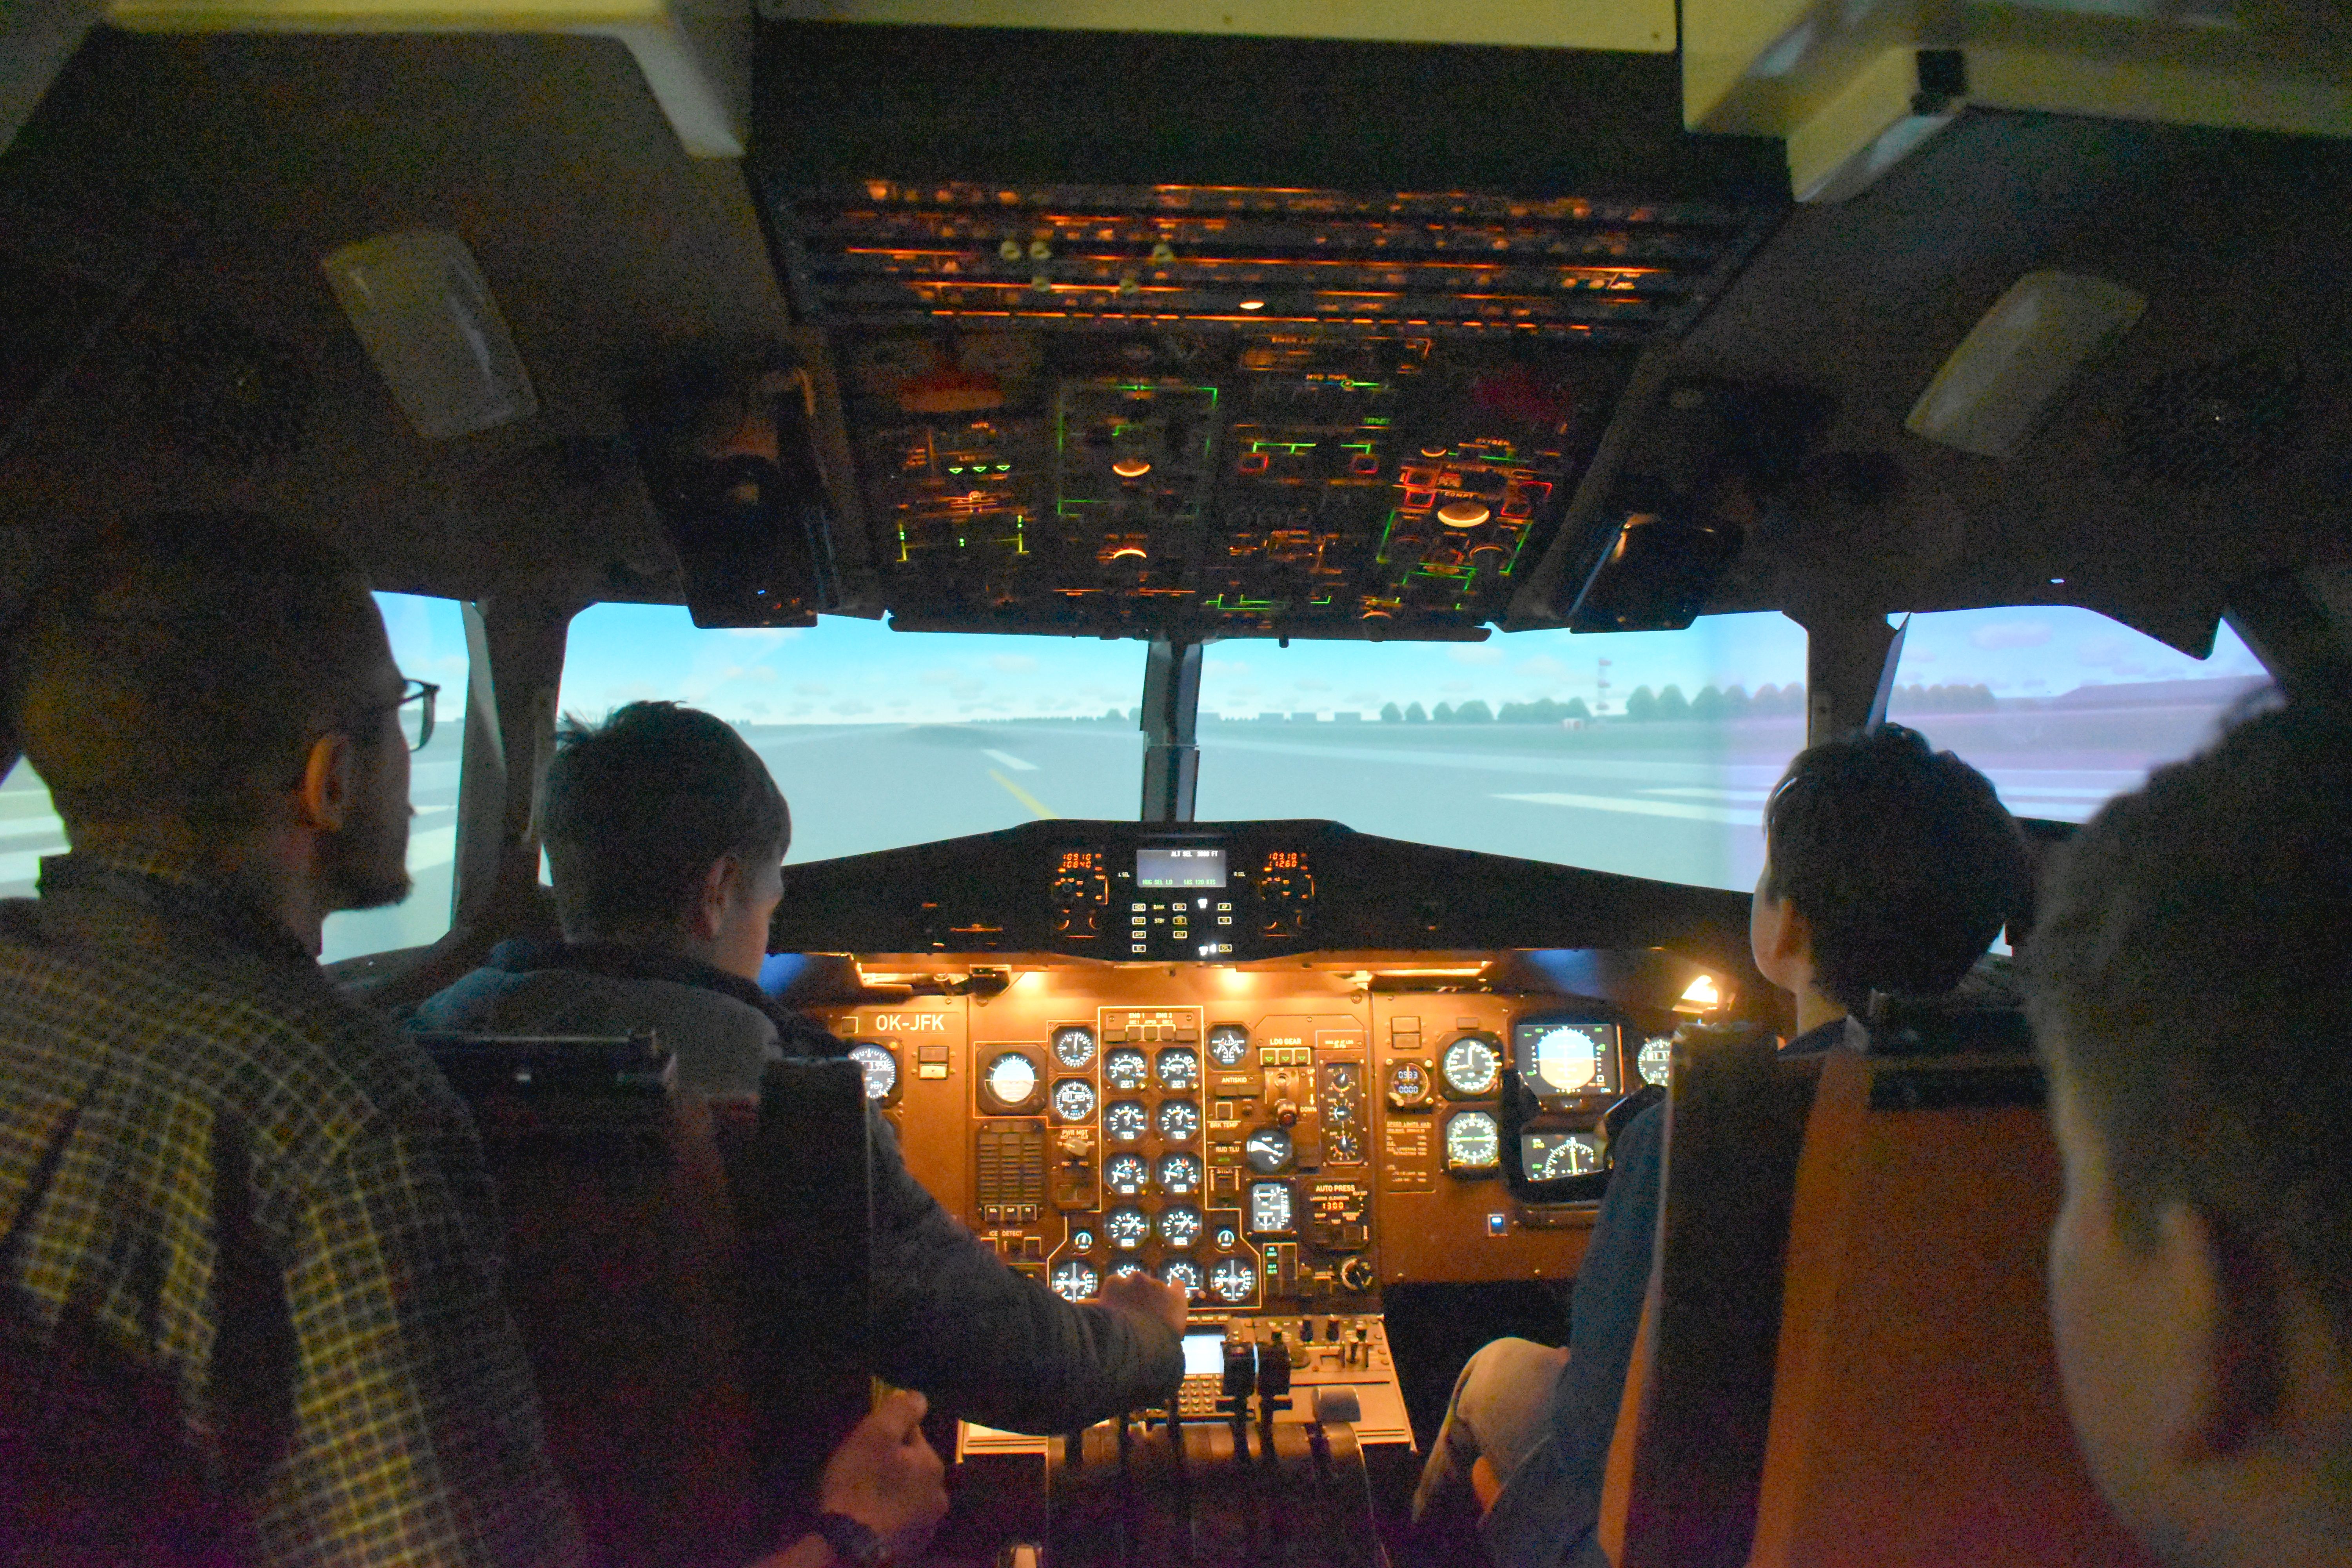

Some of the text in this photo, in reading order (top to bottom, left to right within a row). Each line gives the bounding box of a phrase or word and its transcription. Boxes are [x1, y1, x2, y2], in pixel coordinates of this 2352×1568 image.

[876, 1014, 944, 1031] OK-JFK
[1121, 1080, 1134, 1089] 227
[1172, 1080, 1185, 1089] 227
